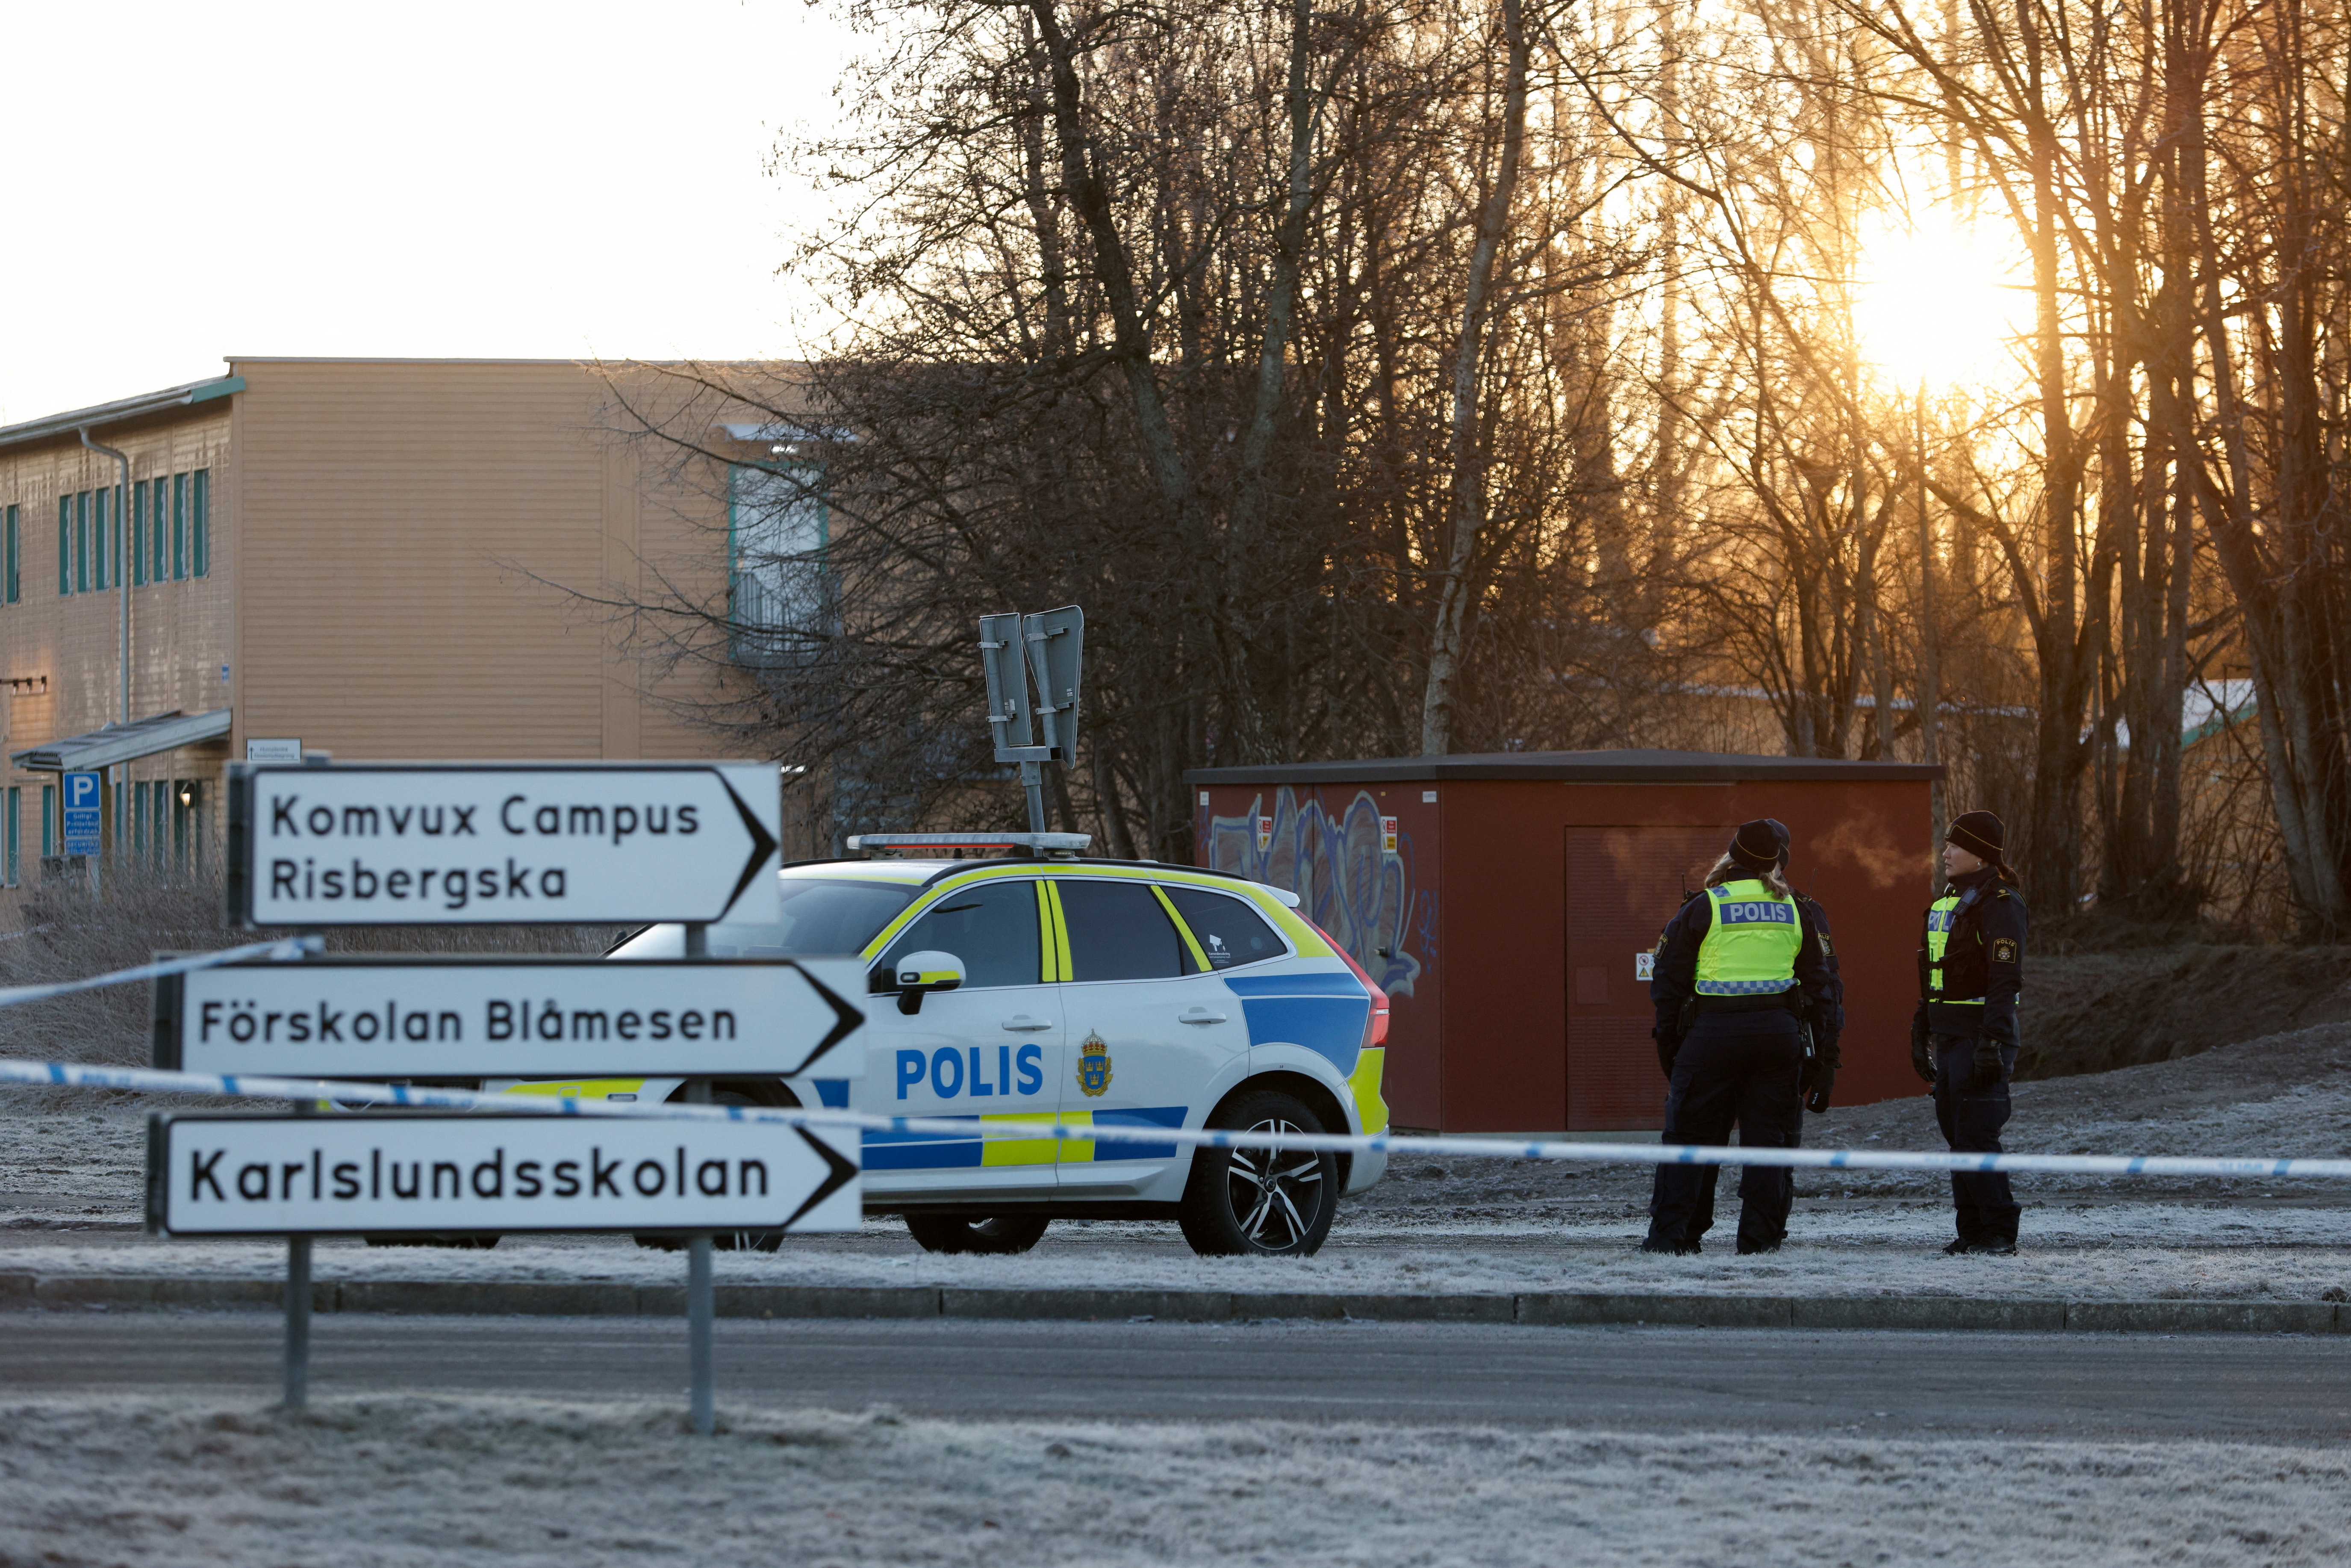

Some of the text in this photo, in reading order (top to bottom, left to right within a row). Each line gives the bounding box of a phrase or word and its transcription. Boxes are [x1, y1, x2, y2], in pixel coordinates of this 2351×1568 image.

[74, 776, 93, 806] P
[273, 795, 699, 845] Komvux Campus
[272, 859, 565, 910] Risbergska
[1730, 903, 1786, 921] POLIS
[201, 999, 735, 1043] Förskolan Blåmesen
[896, 1043, 1043, 1100] POLIS
[191, 1147, 767, 1202] Karlslundsskolan
